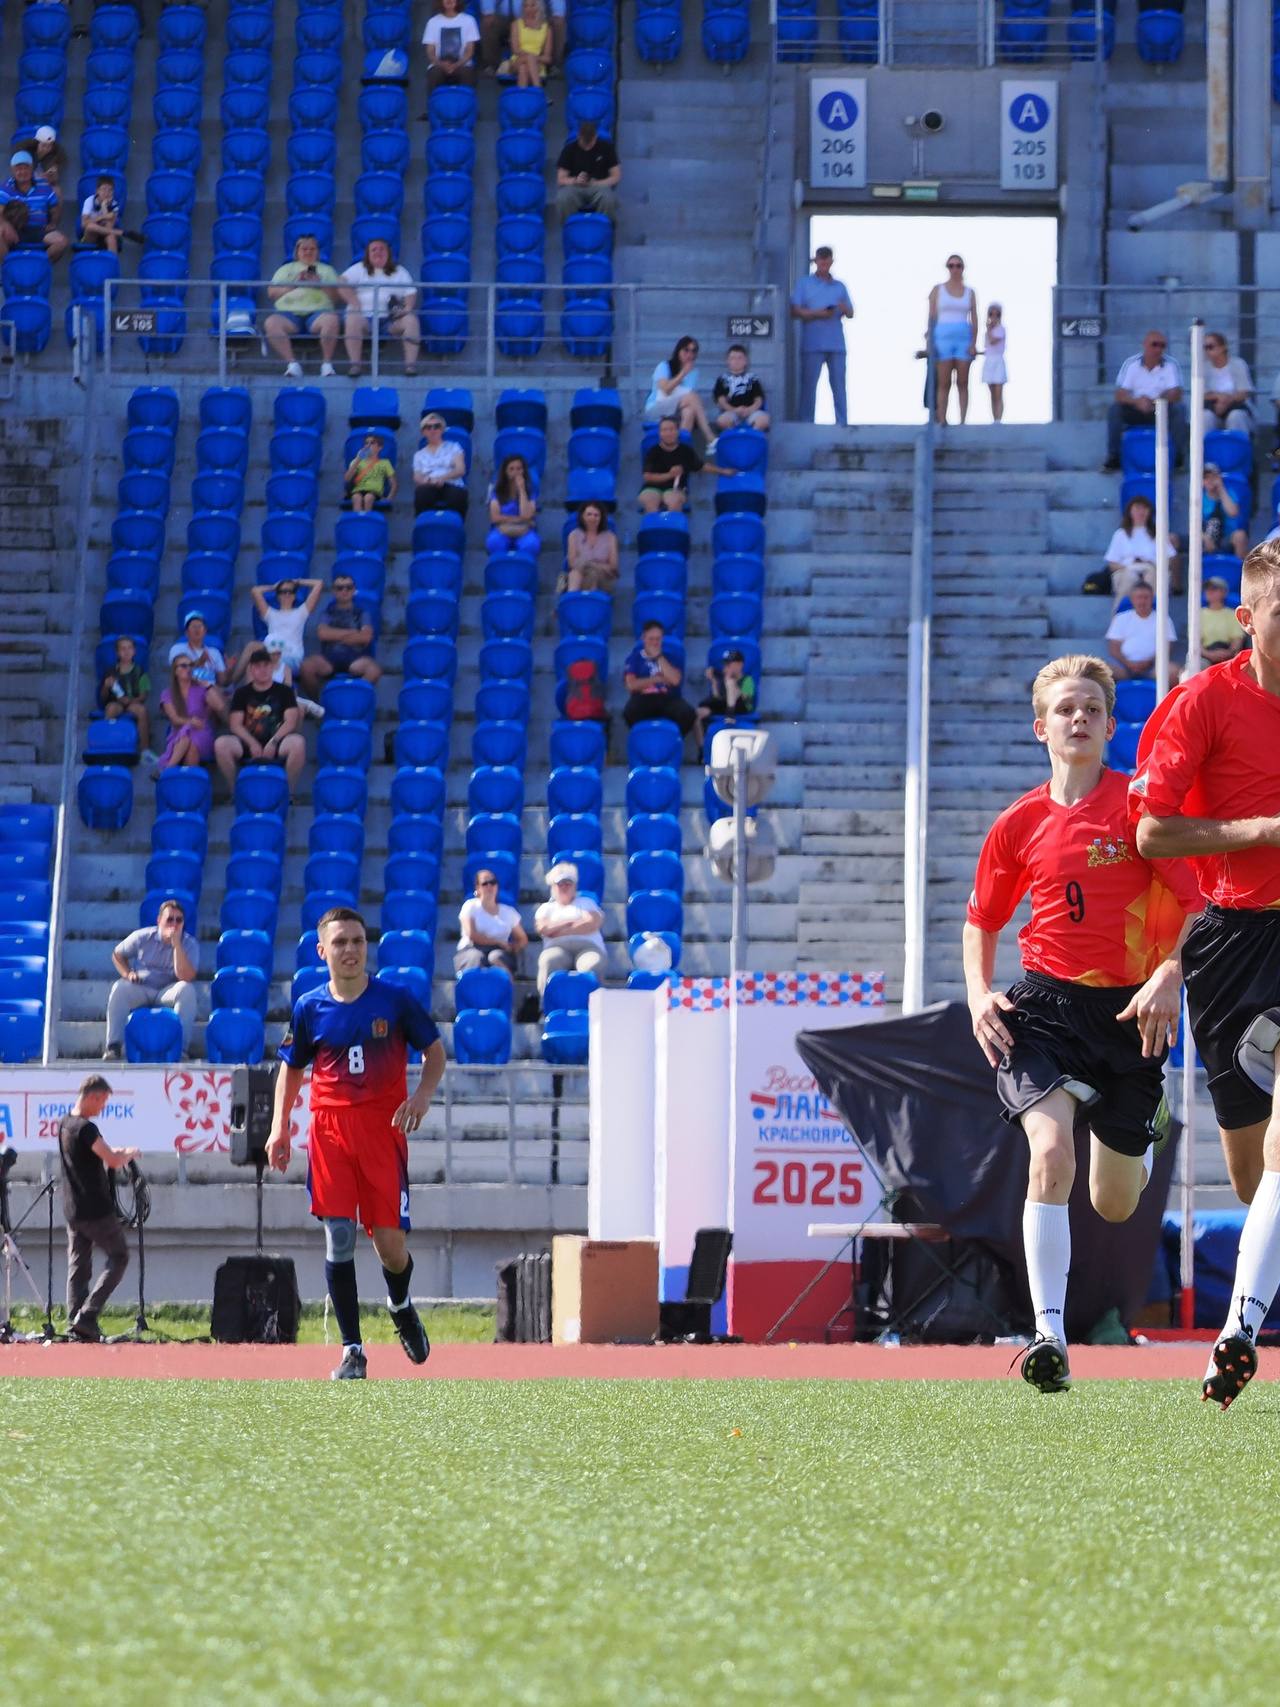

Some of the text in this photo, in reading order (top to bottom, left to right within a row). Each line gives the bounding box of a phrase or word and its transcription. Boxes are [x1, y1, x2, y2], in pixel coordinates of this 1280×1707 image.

[821, 138, 855, 154] 206
[1012, 140, 1047, 156] 205
[822, 162, 854, 178] 104
[1013, 164, 1046, 180] 103
[132, 319, 153, 331] 105
[1066, 881, 1085, 922] 9
[348, 1045, 365, 1074] 8
[759, 1127, 855, 1143] КРАСНОЯРС
[753, 1161, 862, 1205] 2025
